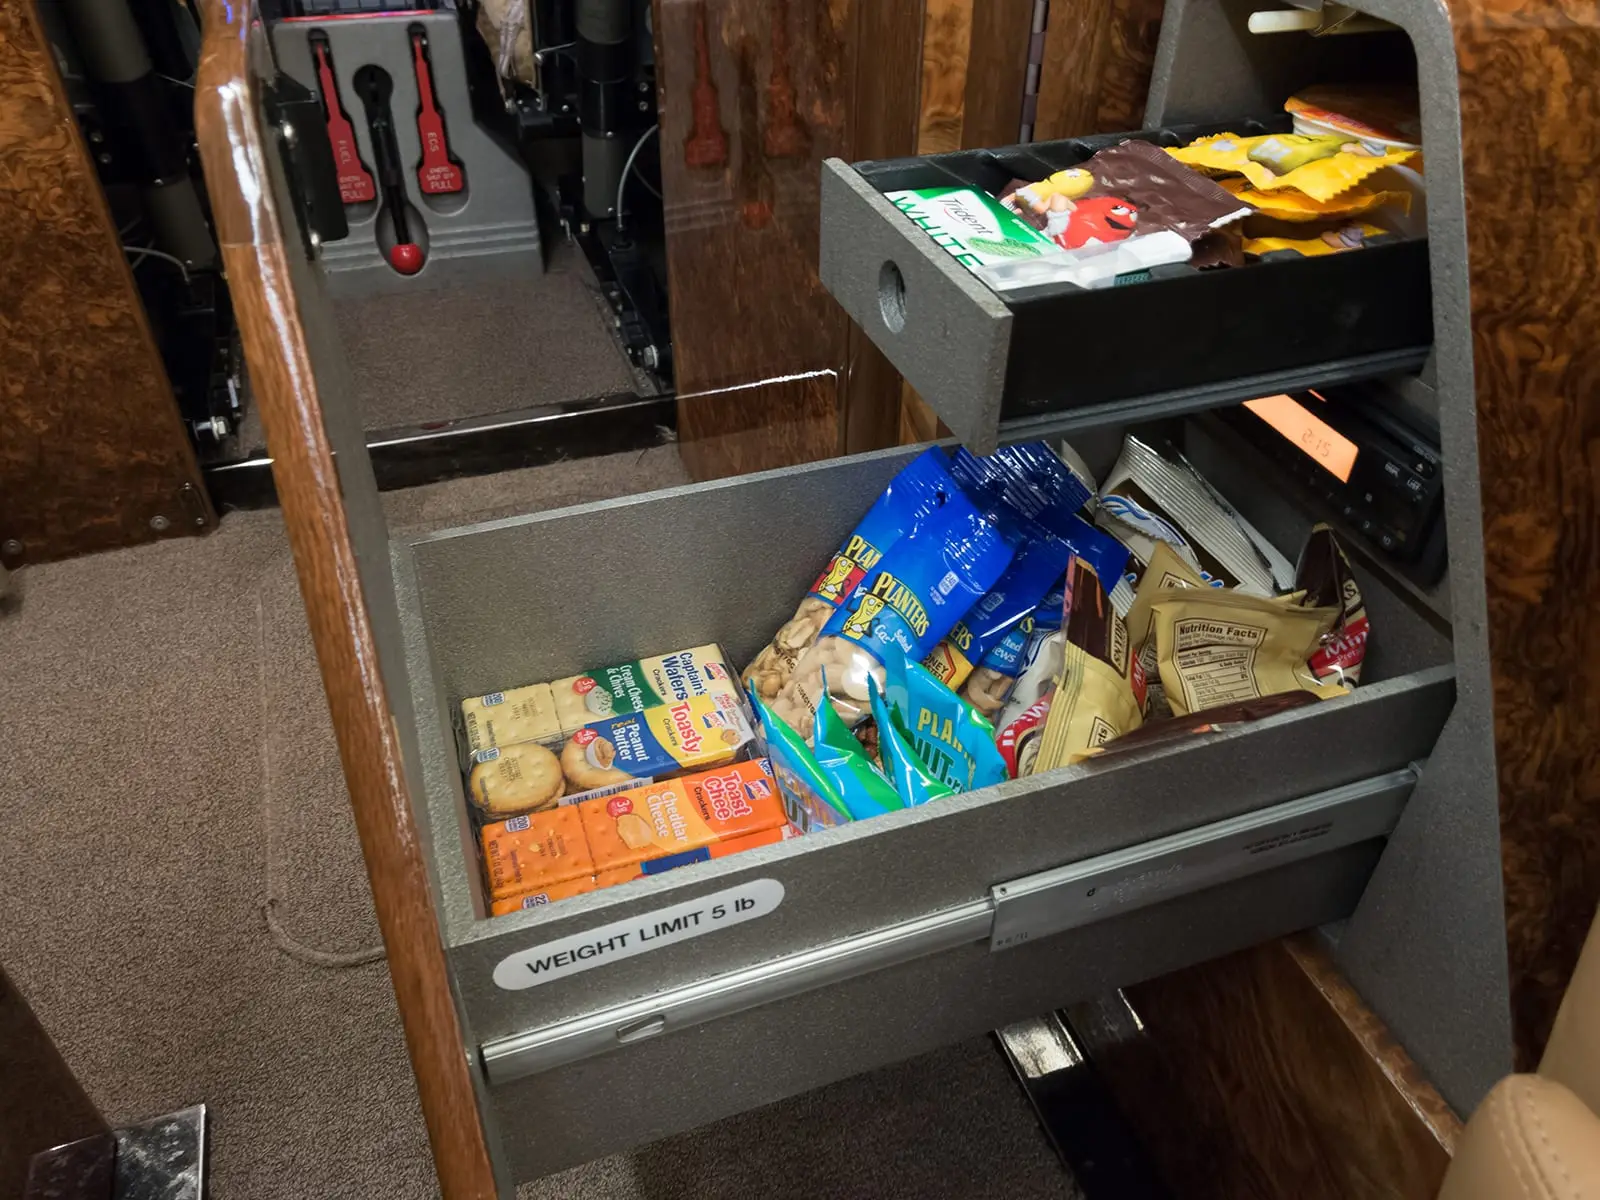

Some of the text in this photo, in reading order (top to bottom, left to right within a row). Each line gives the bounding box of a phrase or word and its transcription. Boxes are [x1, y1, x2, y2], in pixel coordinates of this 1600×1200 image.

[338, 139, 352, 165] FUEL
[341, 189, 365, 200] PULL
[430, 181, 454, 190] PULL
[893, 196, 984, 269] WHITE
[939, 197, 993, 236] Trident
[871, 571, 931, 638] PLANTERS
[1179, 623, 1258, 639] Nutrition Facts
[582, 678, 594, 691] 3g
[609, 674, 625, 698] Chives
[620, 664, 638, 690] Cream
[652, 668, 667, 697] Crackers
[662, 655, 689, 701] Wafers
[680, 652, 707, 697] Captain's
[583, 730, 595, 742] 4g
[613, 727, 632, 761] Butter
[627, 723, 650, 762] Peanut
[663, 717, 678, 747] Crackers
[670, 701, 703, 753] Toasty
[615, 799, 630, 813] 3g
[693, 786, 711, 821] Crackers
[703, 776, 731, 821] Chee
[722, 770, 753, 818] Toast
[517, 815, 529, 829] 200
[646, 794, 669, 838] Cheese
[661, 791, 689, 843] Cheddar
[526, 897, 756, 975] WEIGHT LIMIT 5 lb
